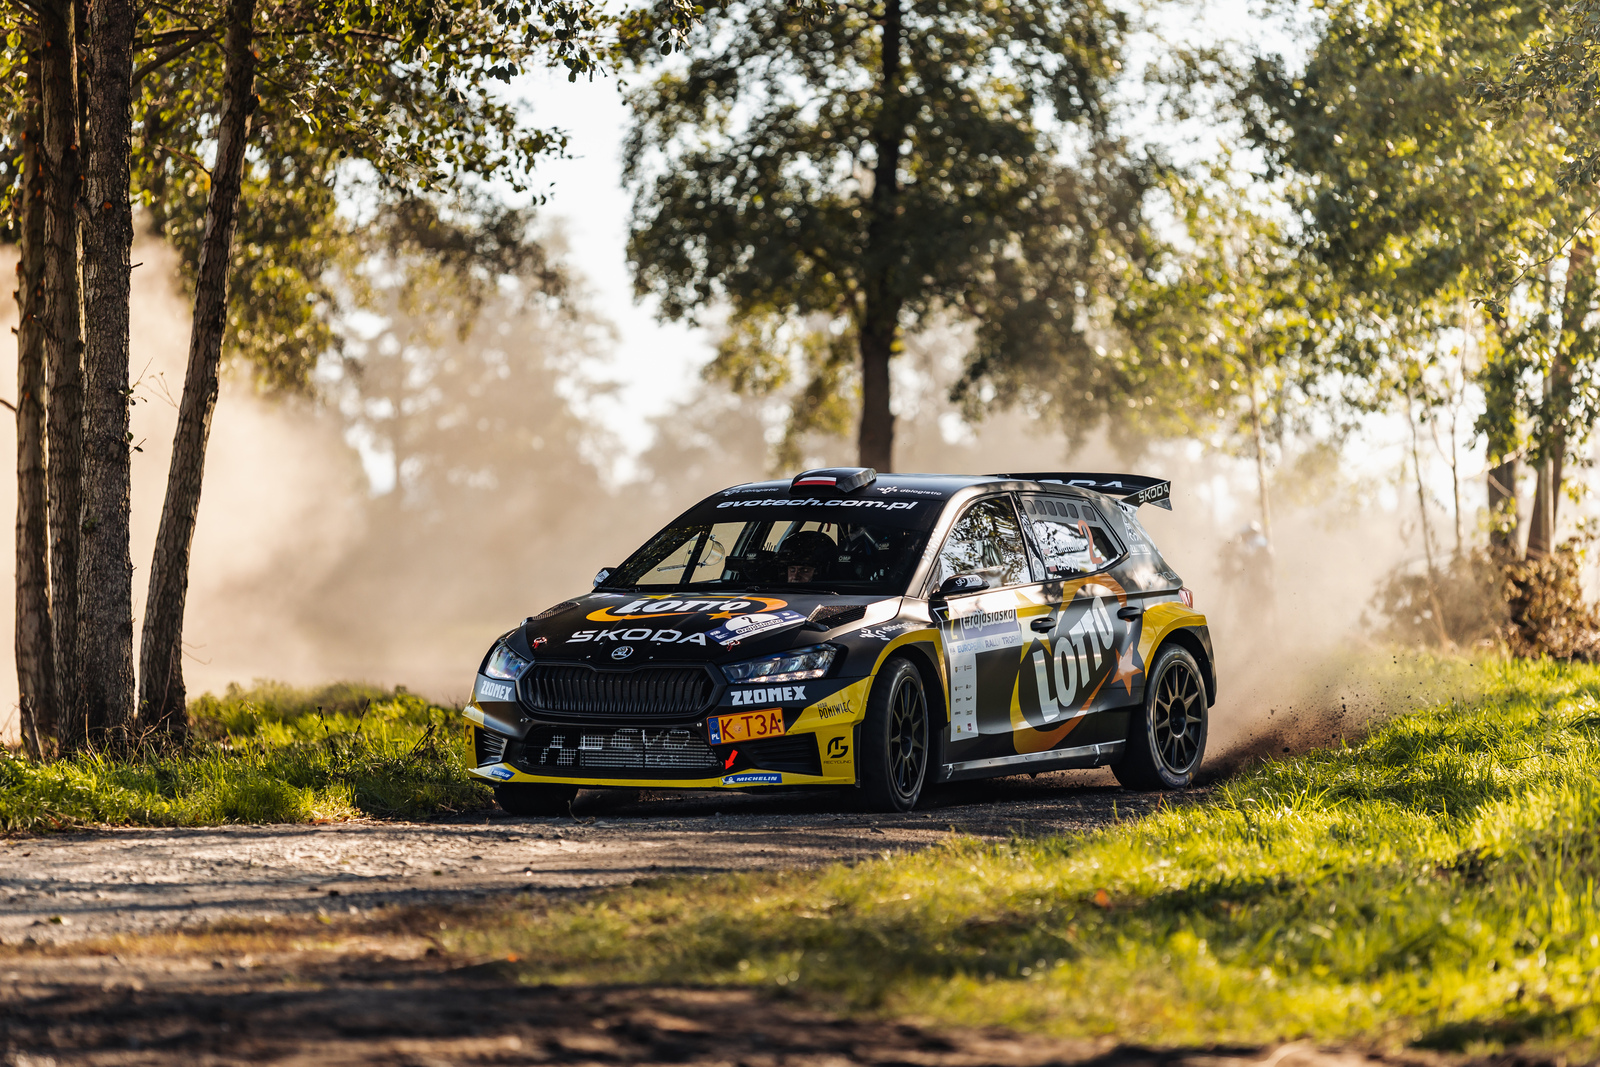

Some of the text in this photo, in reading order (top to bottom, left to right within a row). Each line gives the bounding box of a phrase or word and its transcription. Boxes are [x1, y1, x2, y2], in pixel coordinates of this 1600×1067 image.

[716, 498, 919, 511] evotech.com.pl
[614, 600, 751, 614] LOTTO
[741, 616, 759, 624] 2
[1032, 595, 1114, 723] LOTTO
[721, 713, 782, 740] K T3A
